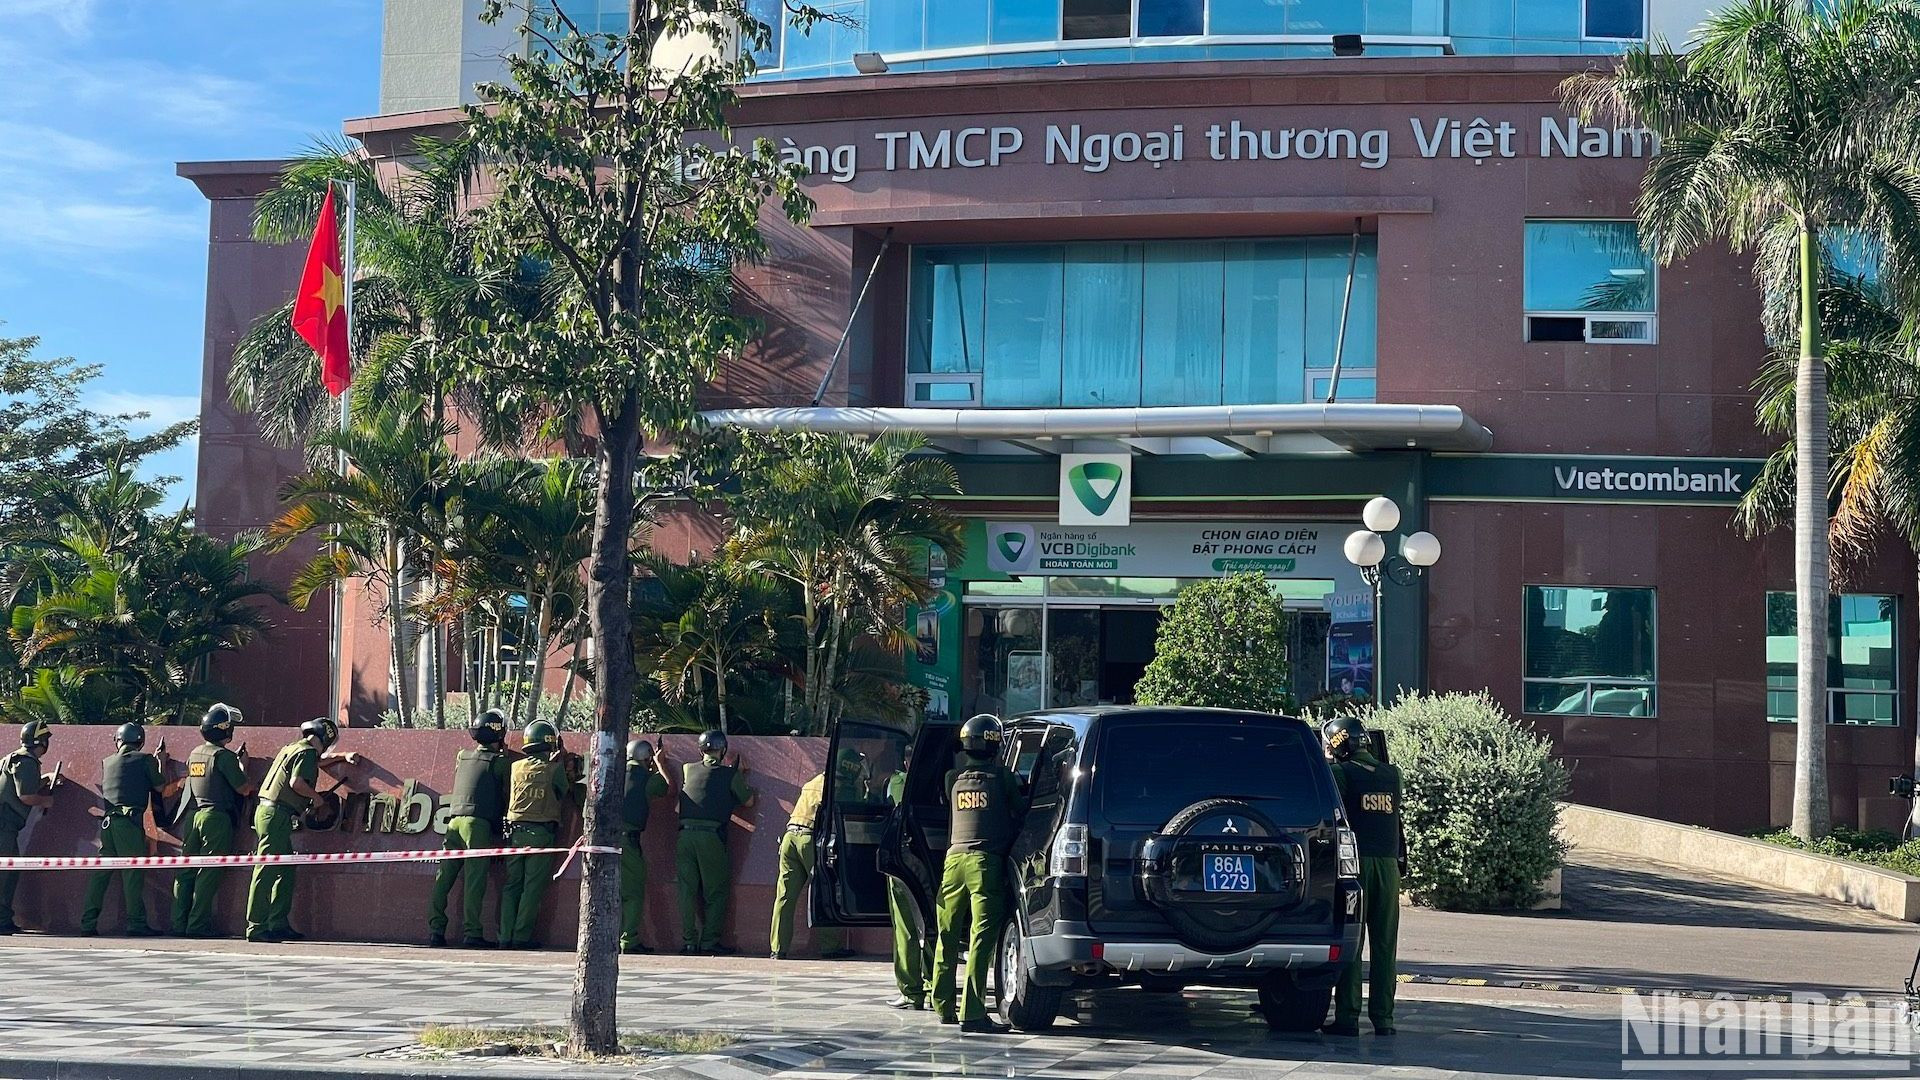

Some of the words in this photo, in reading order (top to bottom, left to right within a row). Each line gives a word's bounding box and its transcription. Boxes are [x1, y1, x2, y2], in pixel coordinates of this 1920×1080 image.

[874, 127, 1024, 172] TMCP
[1045, 124, 1184, 172] Ngoại
[1205, 120, 1389, 169] thương
[1410, 116, 1517, 165] Việt
[1540, 116, 1661, 158] Nam
[1554, 466, 1742, 493] Vietcombank
[1201, 530, 1241, 542] CHỌN
[1245, 530, 1280, 541] GIAO
[1284, 528, 1318, 542] DIỆN
[1192, 541, 1220, 556] BẬT
[1223, 544, 1274, 555] PHONG
[1278, 542, 1317, 555] CÁCH
[1330, 728, 1350, 749] CSHS
[957, 791, 988, 810] CSHS
[1362, 794, 1393, 813] CSHS
[1214, 857, 1243, 873] 86A
[1211, 873, 1249, 890] 1279
